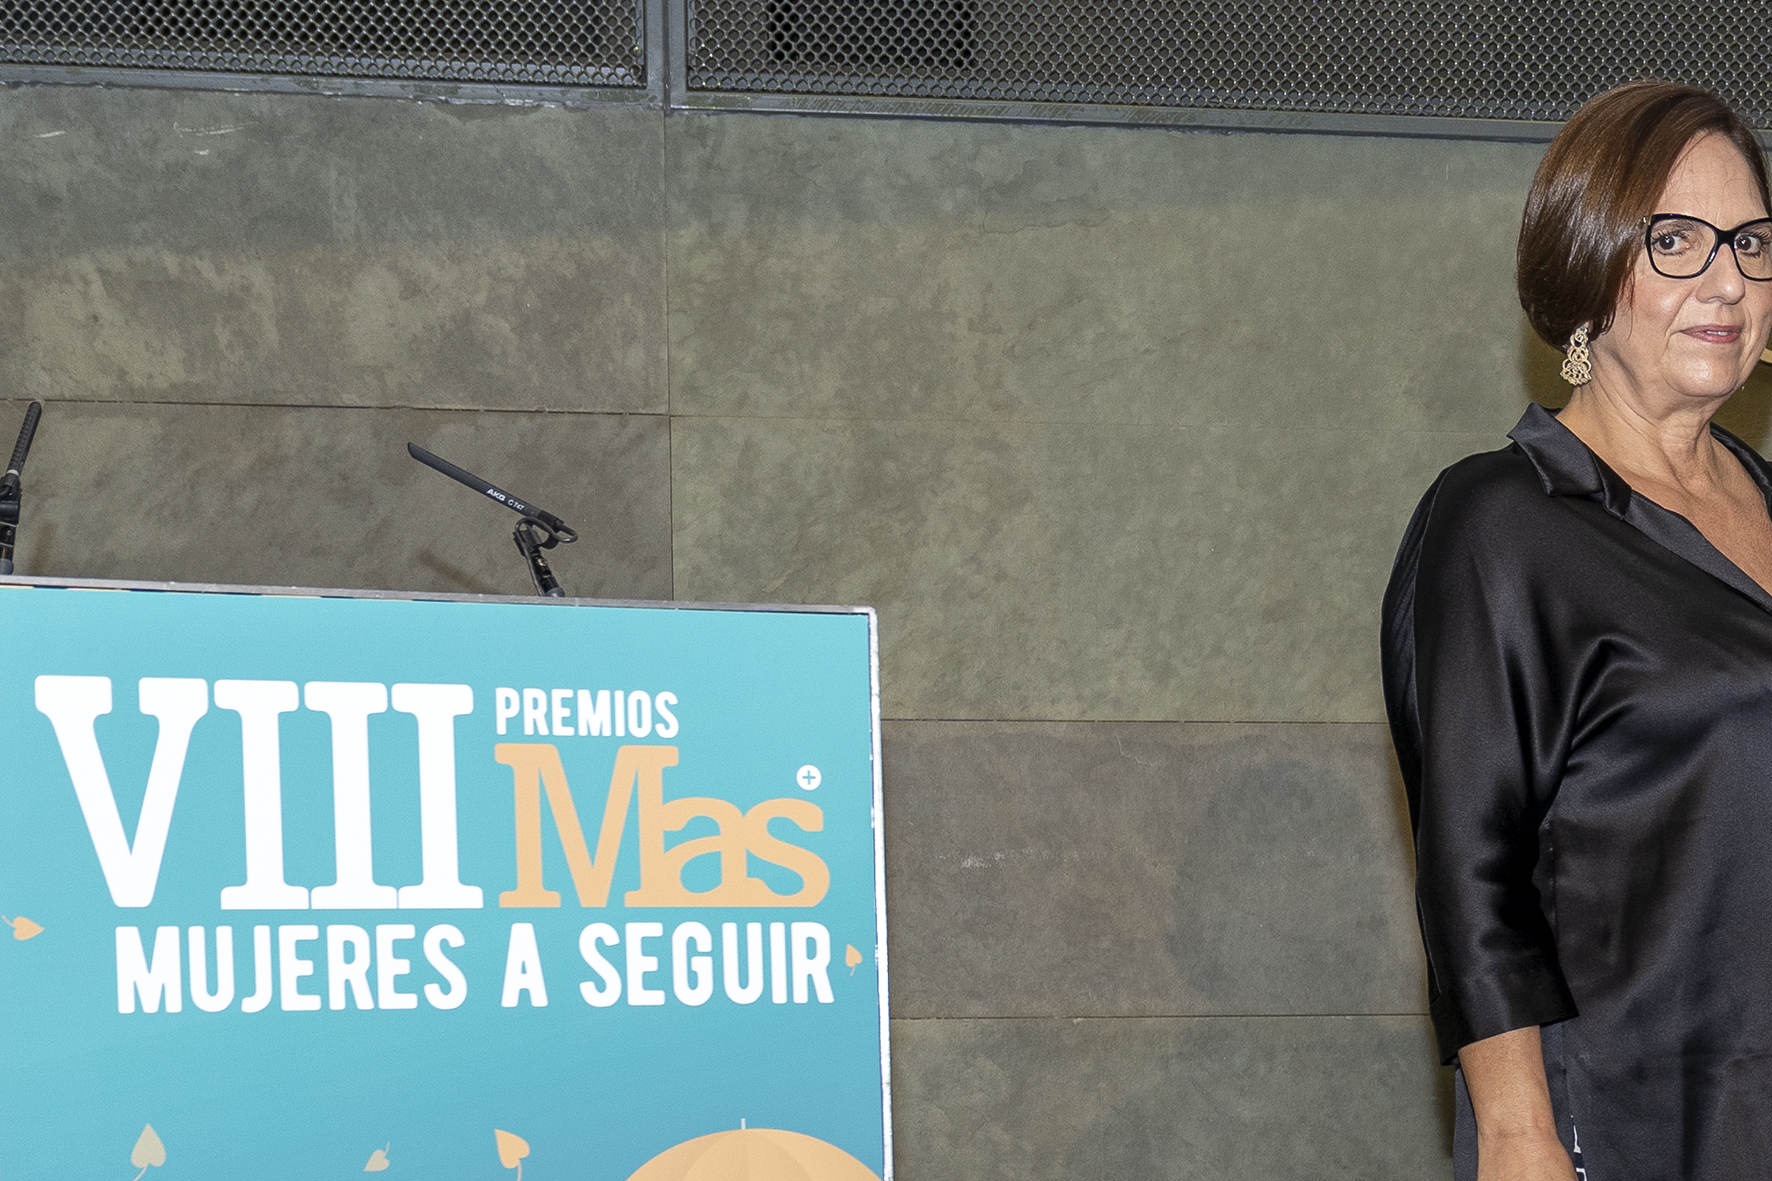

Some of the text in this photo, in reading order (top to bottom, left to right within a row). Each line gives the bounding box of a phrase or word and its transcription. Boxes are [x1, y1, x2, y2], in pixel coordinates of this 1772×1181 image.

[487, 488, 506, 501] AKG
[496, 687, 679, 738] PREMIOS
[35, 675, 483, 909] VIII
[495, 744, 831, 907] Mas
[115, 921, 835, 1013] MUJERES A SEGUIR
